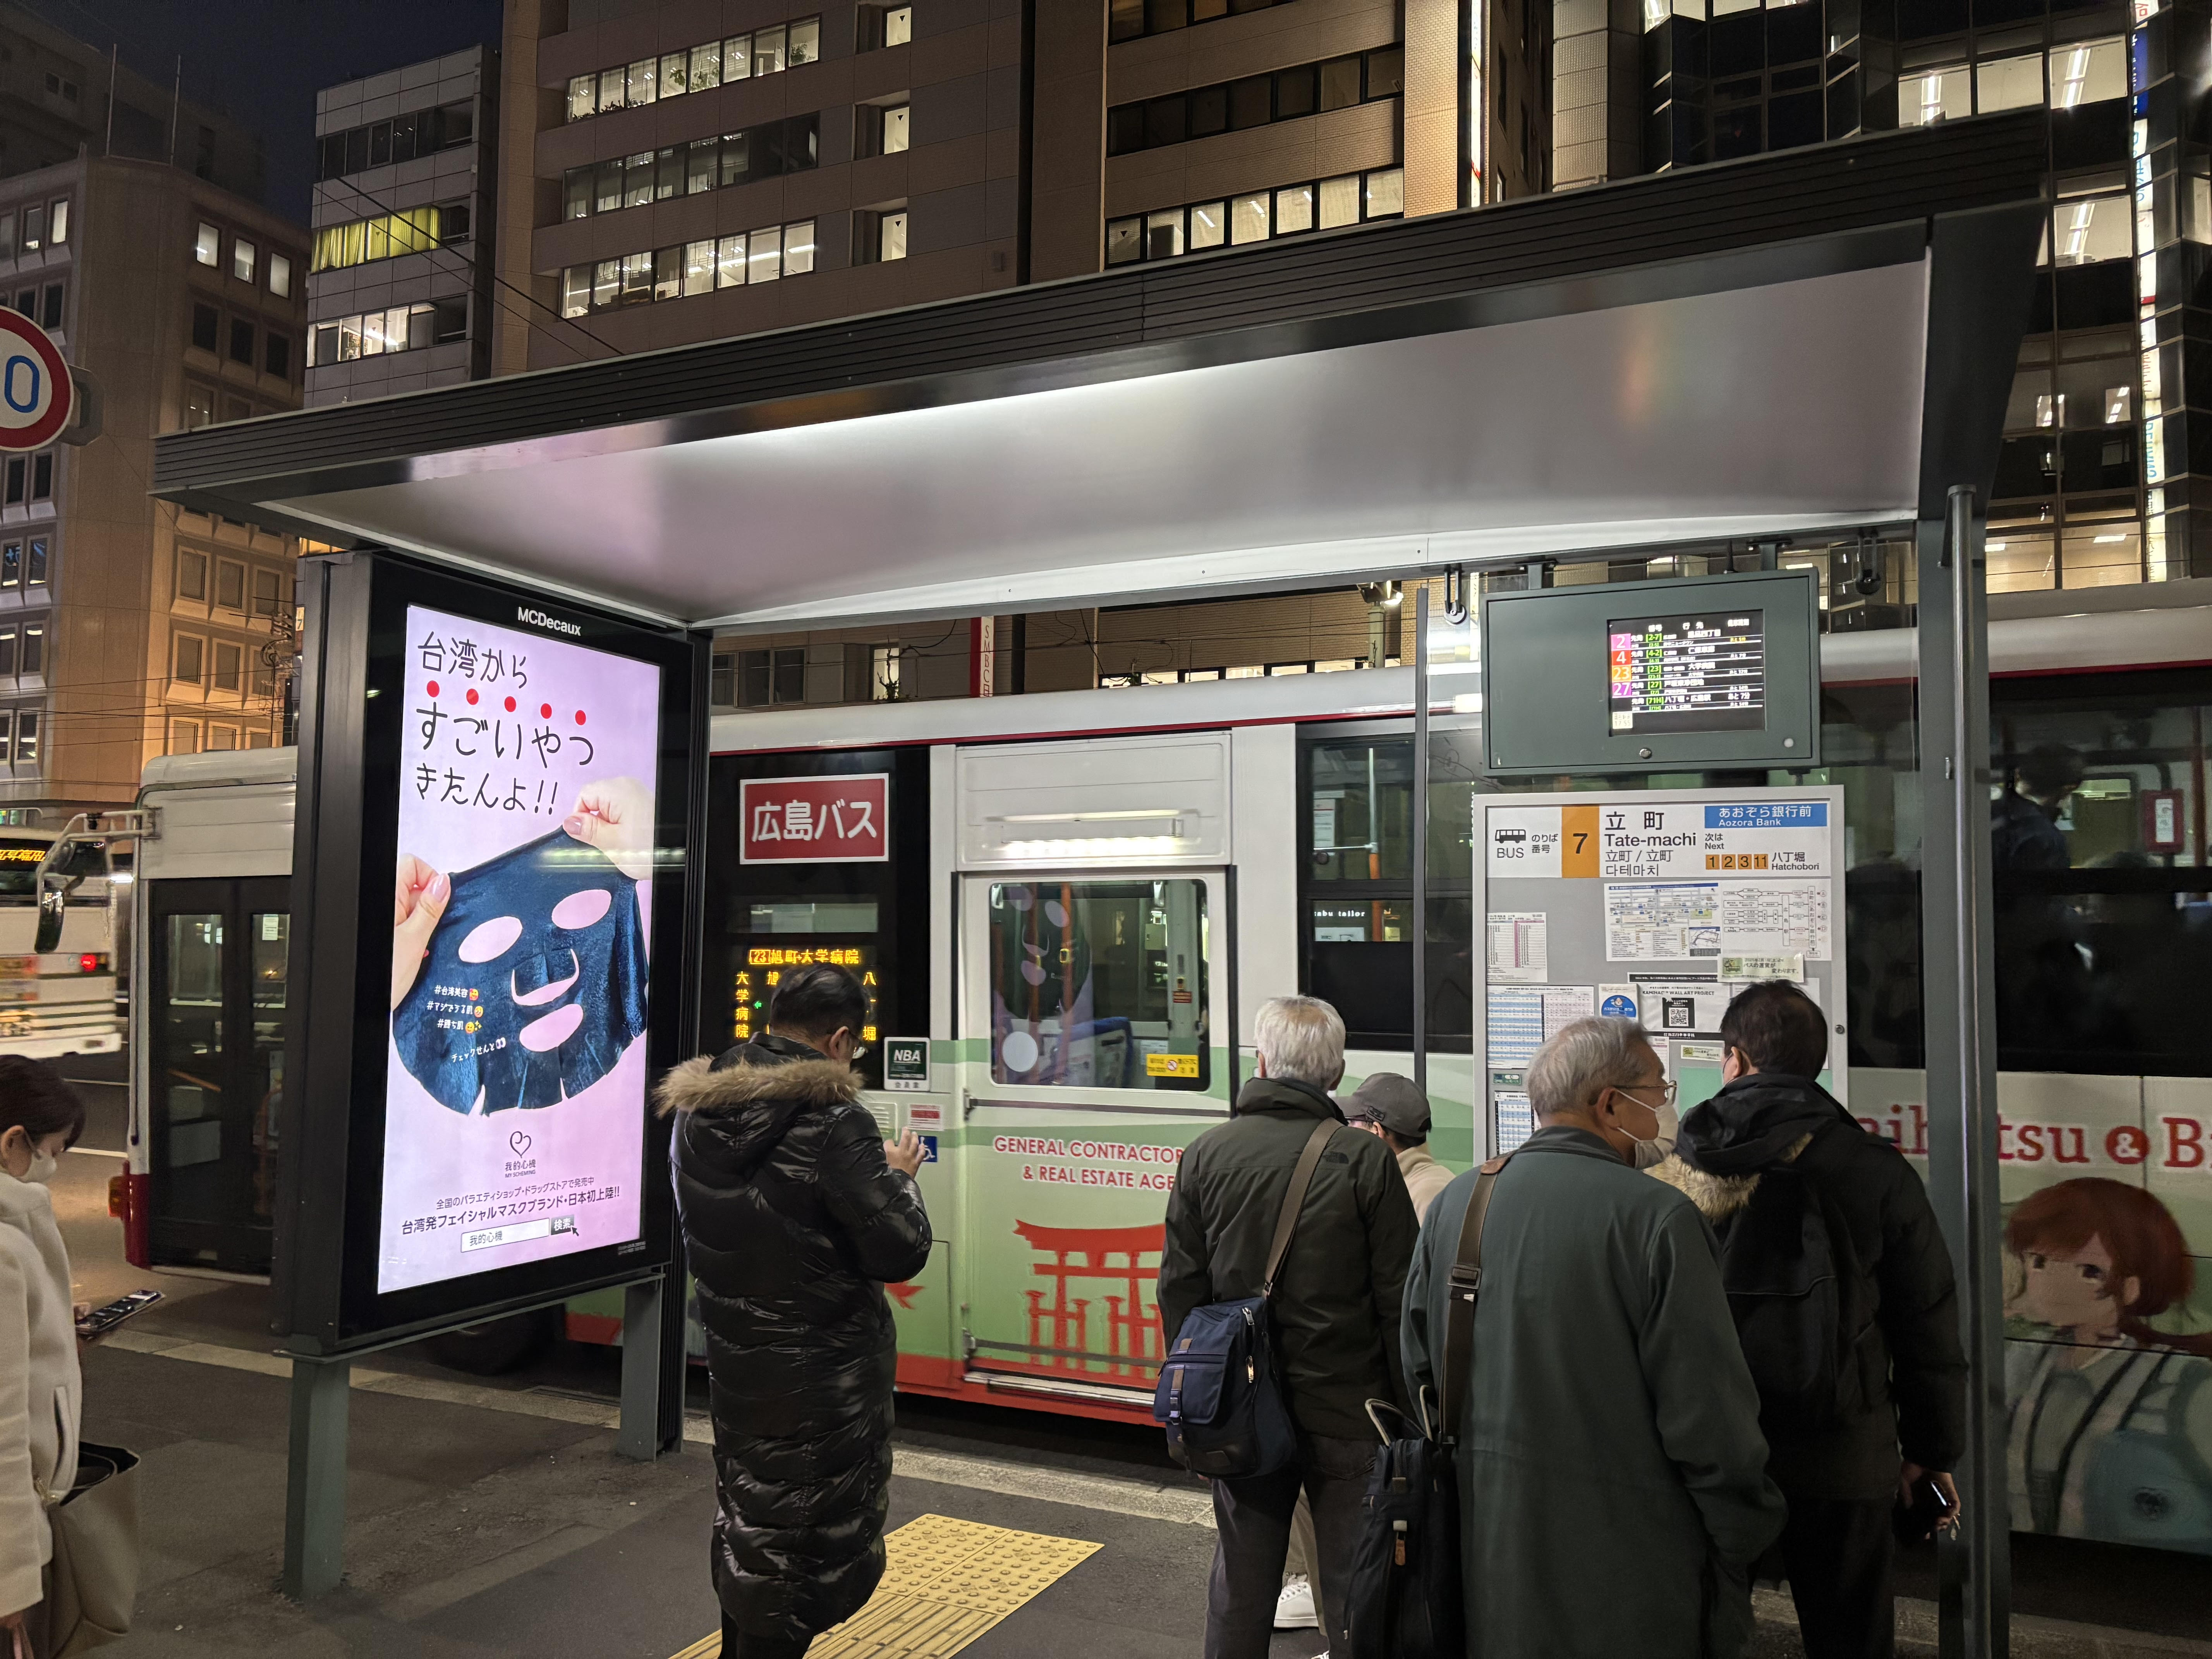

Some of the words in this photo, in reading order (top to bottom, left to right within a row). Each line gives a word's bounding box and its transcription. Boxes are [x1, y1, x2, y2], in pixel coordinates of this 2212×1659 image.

[4, 355, 40, 413] 0
[518, 607, 581, 636] MCDecaux
[1616, 635, 1626, 648] 2
[417, 631, 527, 689] 台湾から
[1616, 651, 1626, 664] 4
[1613, 667, 1630, 680] 23
[1614, 682, 1630, 696] 27
[416, 702, 594, 769] すごいやつ
[1719, 805, 1812, 818] あおぞら銀行前
[752, 799, 877, 842] 広島バス
[1532, 834, 1558, 842] のりば
[1573, 833, 1588, 854] 7
[1604, 833, 1697, 847] Tate-machi
[1705, 833, 1723, 842] 次は
[1497, 848, 1524, 858] BUS
[1532, 845, 1551, 853] 番号
[1605, 850, 1633, 862] 立町
[1645, 849, 1674, 862] 立町
[1709, 856, 1714, 868] 1
[1724, 856, 1733, 868] 2
[1740, 856, 1749, 868] 3
[1754, 857, 1767, 867] 11
[1772, 852, 1805, 862] 八丁堀
[1606, 864, 1659, 876] 다테마치
[736, 970, 749, 1038] 大学病院
[863, 971, 877, 1041] 八堀
[893, 1049, 921, 1061] NBA
[2162, 1116, 2212, 1168] B
[994, 1137, 1065, 1156] GENERAL
[1070, 1142, 1183, 1163] CONTRACTOR
[513, 1170, 536, 1178] SCHEMING
[1023, 1166, 1033, 1180] &
[1039, 1166, 1076, 1183] REAL
[1082, 1169, 1133, 1187] ESTATE
[554, 1218, 571, 1231] 検索
